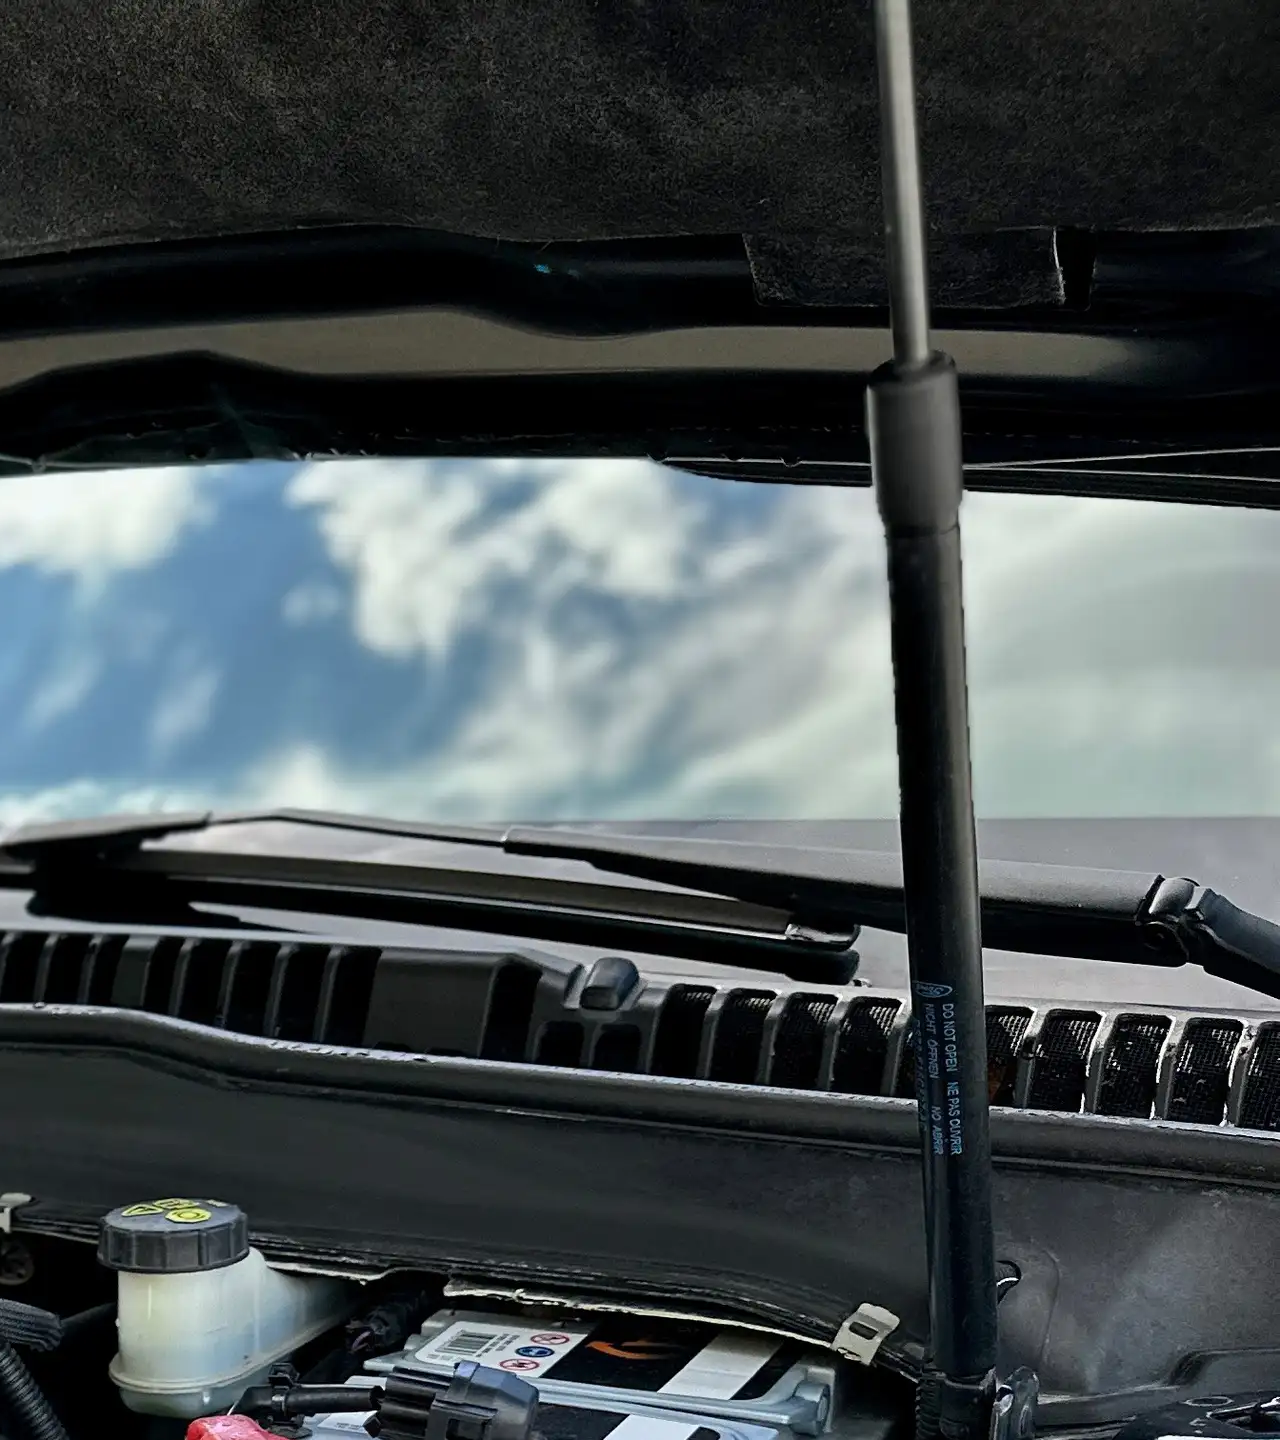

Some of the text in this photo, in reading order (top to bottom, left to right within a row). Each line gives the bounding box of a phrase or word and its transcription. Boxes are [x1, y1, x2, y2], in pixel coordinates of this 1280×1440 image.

[924, 1003, 937, 1035] NICHT
[942, 1003, 958, 1072] DO NOT OPEN
[931, 1106, 942, 1121] NO
[946, 1081, 963, 1156] NE PAS OUVRIR
